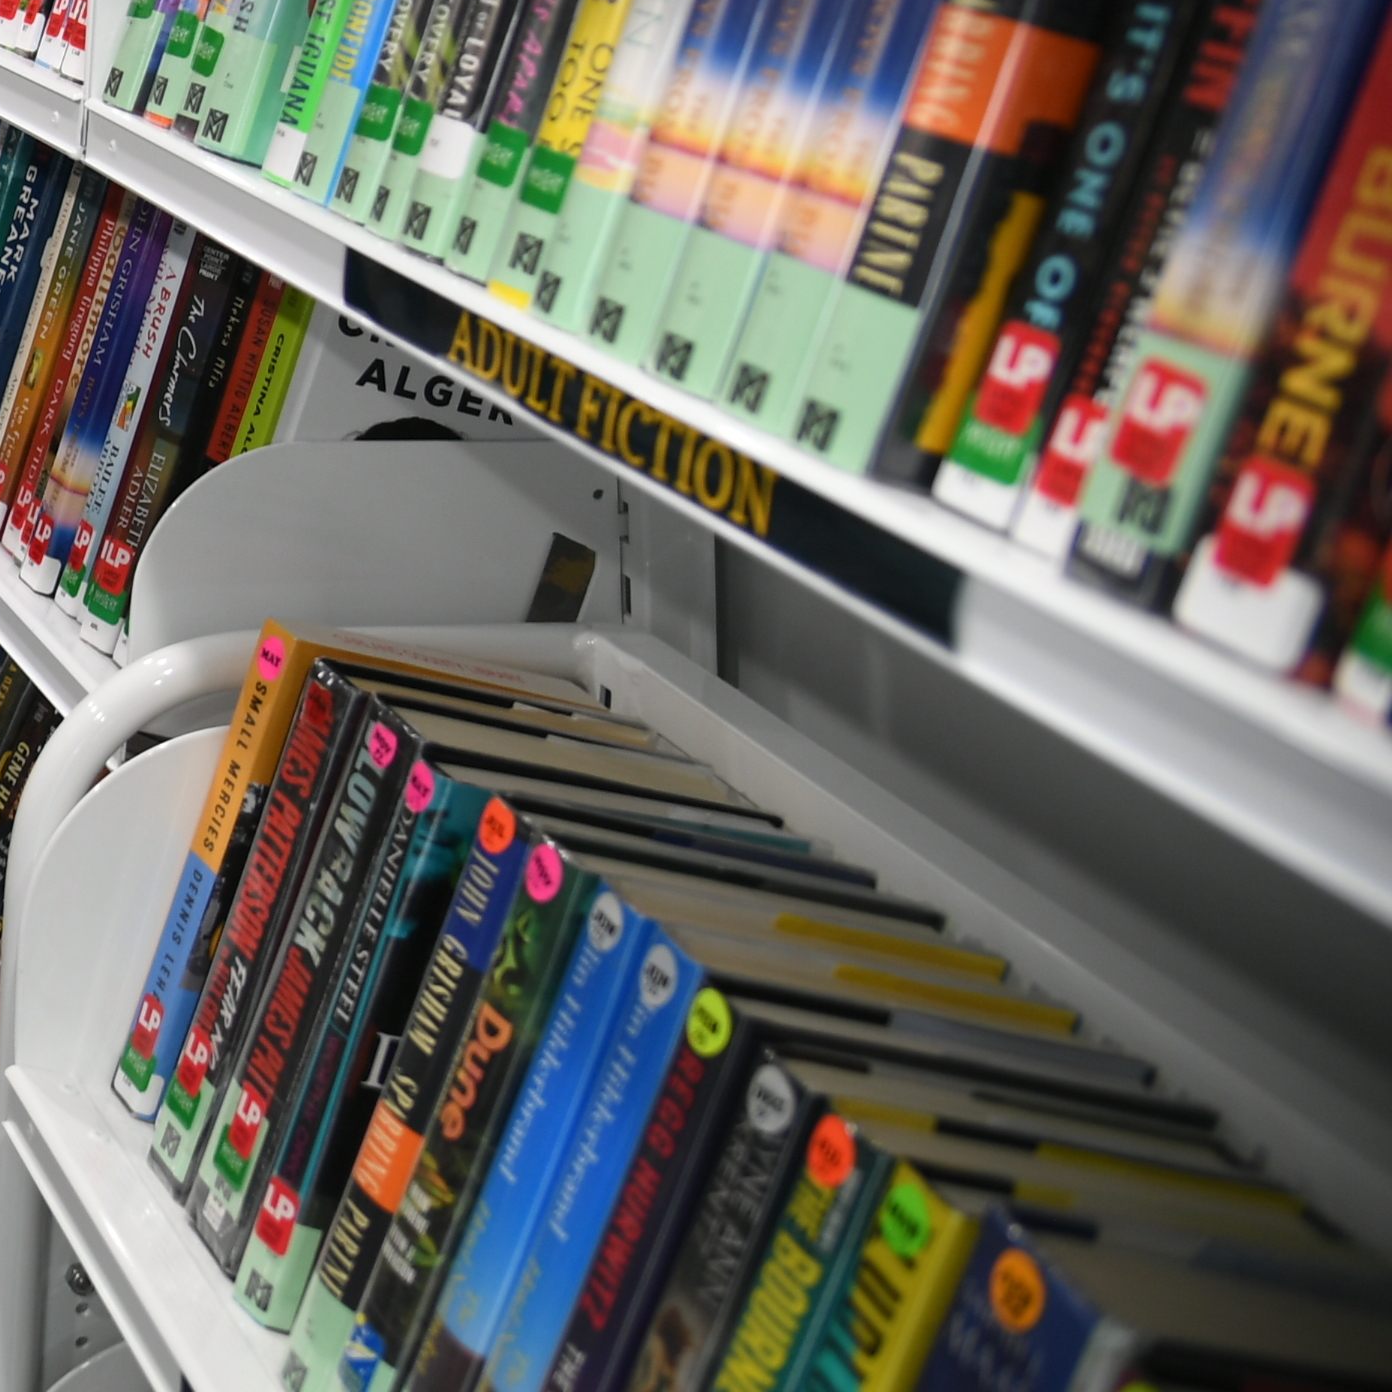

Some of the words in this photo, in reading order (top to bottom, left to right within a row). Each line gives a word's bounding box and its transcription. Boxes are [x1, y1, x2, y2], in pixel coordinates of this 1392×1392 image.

[278, 31, 326, 127] IGUANA
[1106, 2, 1170, 104] IT'S
[1055, 121, 1126, 241] ONE
[5, 199, 40, 282] MARK
[66, 201, 86, 258] JANE
[40, 265, 67, 339] GREEN
[93, 259, 133, 366] GRISHAM
[142, 289, 171, 359] BRUSH
[188, 294, 205, 322] The
[159, 327, 197, 429] Charmers
[253, 332, 286, 417] CRISTINA
[988, 334, 1052, 386] LP
[42, 378, 64, 434] DARK
[445, 308, 569, 428] ADULT
[575, 376, 780, 537] FICTION
[1132, 368, 1204, 430] LP
[94, 445, 119, 514] BAILEE
[116, 465, 145, 529] ADLER
[1226, 474, 1309, 536] LP
[34, 519, 52, 542] LP
[76, 525, 90, 549] LP
[261, 647, 281, 668] MAY
[235, 681, 268, 750] SMALL
[6, 741, 31, 783] GENE
[202, 759, 242, 853] MERCIES
[172, 870, 203, 946] DENNIS
[228, 792, 304, 961] PATTERSON
[365, 812, 416, 944] DANIELLE
[456, 848, 500, 927] JOHN
[140, 1004, 162, 1032] LP
[337, 950, 373, 1022] STEEL
[407, 932, 469, 1056] GRISHAM
[187, 1033, 209, 1064] LP
[441, 999, 514, 1140] Dune
[237, 1091, 261, 1126] LP
[264, 1182, 295, 1219] LP
